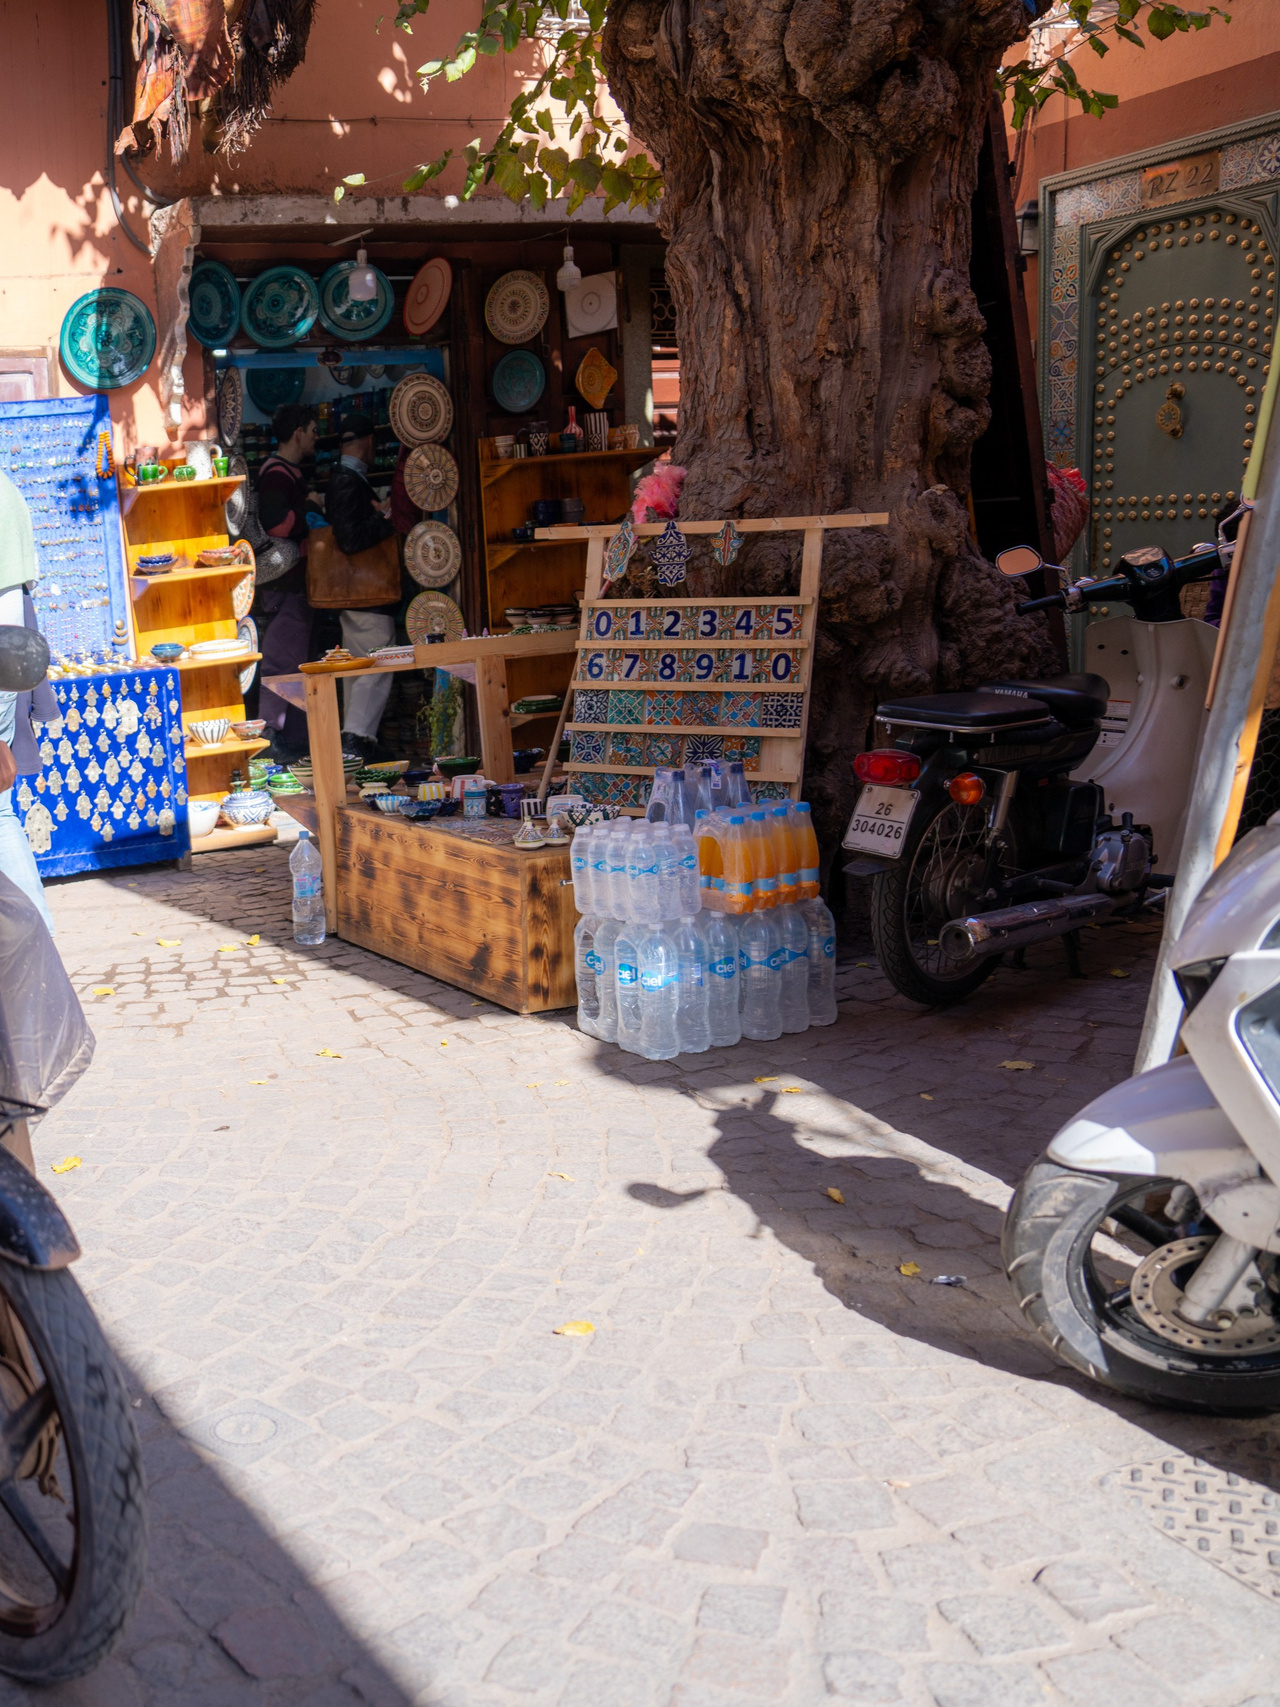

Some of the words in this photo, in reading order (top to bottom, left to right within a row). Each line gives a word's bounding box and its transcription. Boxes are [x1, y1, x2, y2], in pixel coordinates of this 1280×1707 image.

[1147, 170, 1179, 199] RZ
[1185, 162, 1213, 189] 22
[594, 610, 612, 638] 0
[629, 611, 645, 636] 1
[664, 611, 681, 637] 2
[699, 610, 717, 637] 3
[735, 610, 753, 635] 4
[774, 608, 793, 635] 5
[588, 653, 605, 679] 6
[623, 654, 640, 679] 7
[659, 653, 677, 680] 8
[696, 653, 714, 680] 9
[733, 654, 751, 680] 1
[772, 653, 791, 680] 0
[994, 688, 1029, 699] YAMAHA
[874, 802, 894, 816] 26
[852, 819, 903, 839] 304026
[715, 959, 736, 974] ciel
[641, 973, 662, 987] ciel
